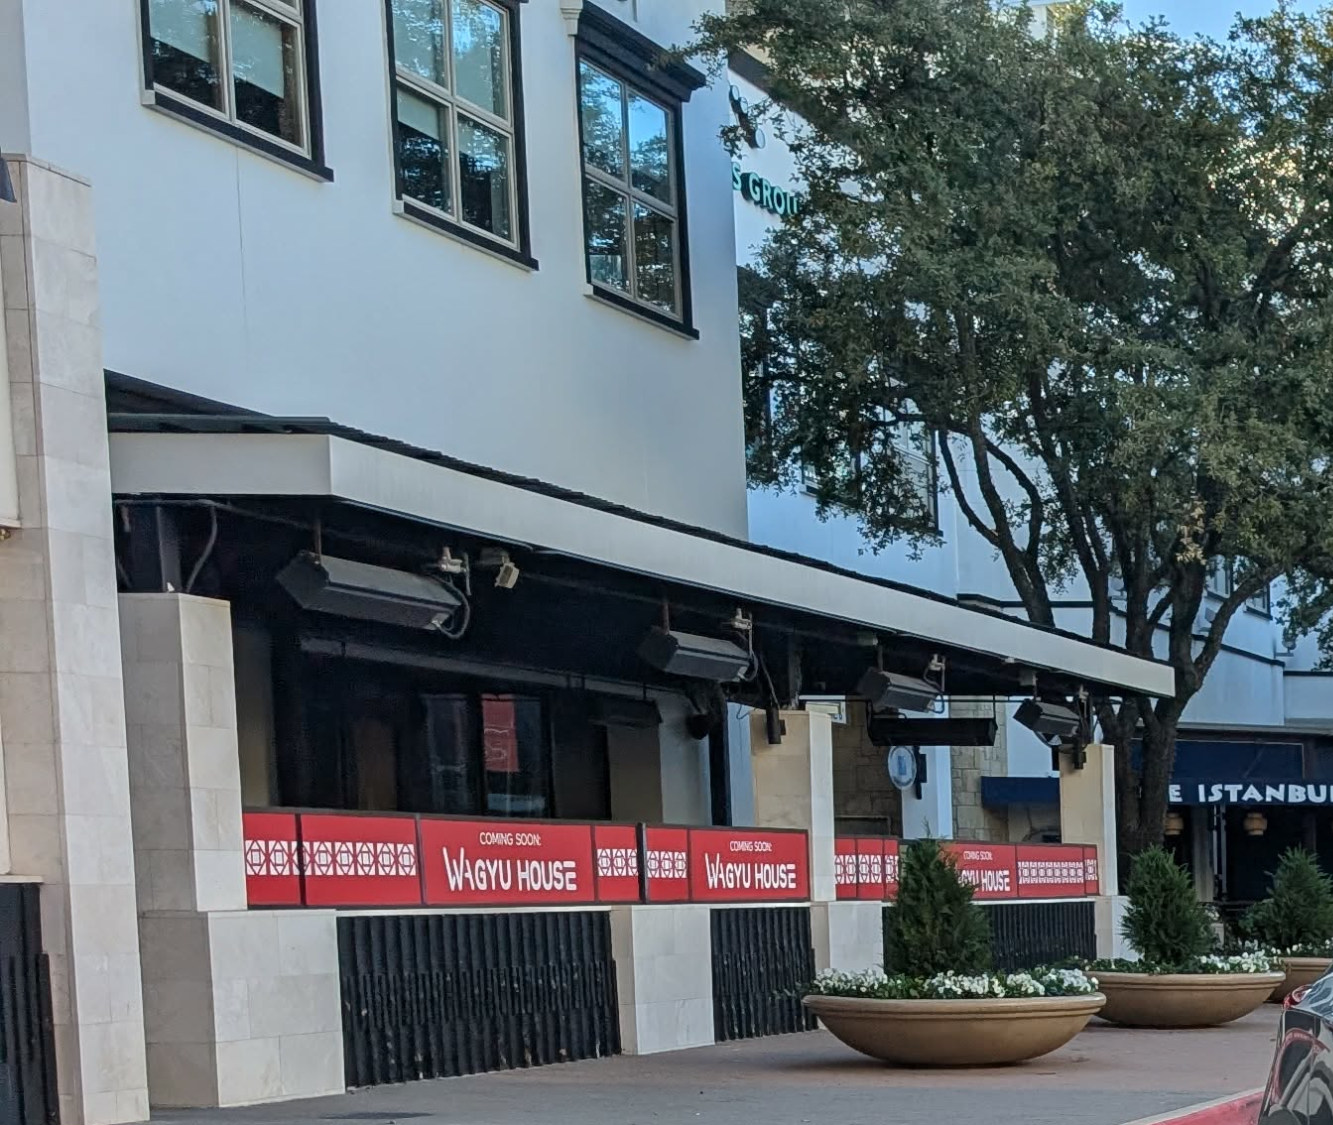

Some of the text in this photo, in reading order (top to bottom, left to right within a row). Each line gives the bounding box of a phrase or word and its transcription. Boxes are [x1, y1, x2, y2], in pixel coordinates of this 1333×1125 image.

[479, 831, 514, 846] COMING
[729, 840, 753, 852] COMING
[443, 847, 577, 892] WAGYU HOUSE
[705, 853, 797, 890] WAGYU HOUSE
[981, 869, 1011, 892] HOUSE
